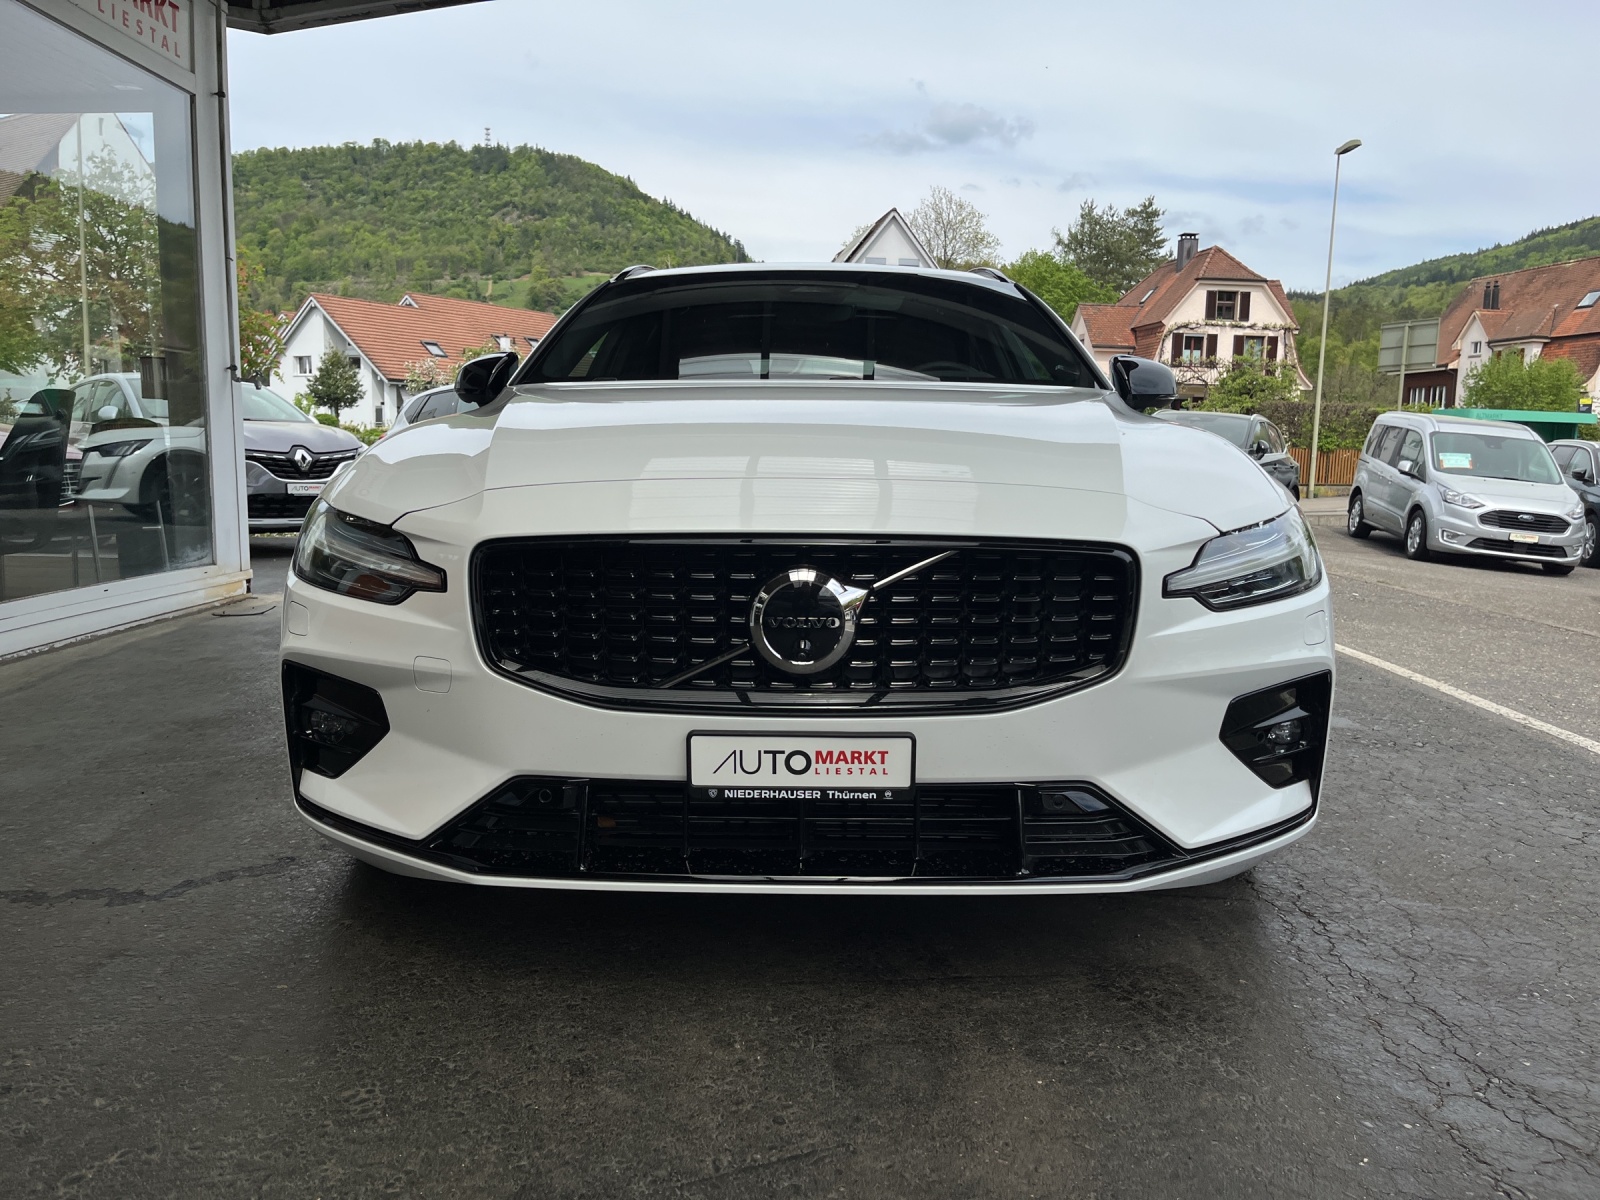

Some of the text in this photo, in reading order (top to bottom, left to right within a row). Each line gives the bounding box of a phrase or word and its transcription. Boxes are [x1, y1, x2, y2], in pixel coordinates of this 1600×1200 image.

[98, 0, 180, 58] LIESTAL
[767, 617, 840, 628] VOLVO
[713, 750, 889, 775] AUTO MARKT
[725, 790, 876, 799] NIEDERHAUSER Thürnen
